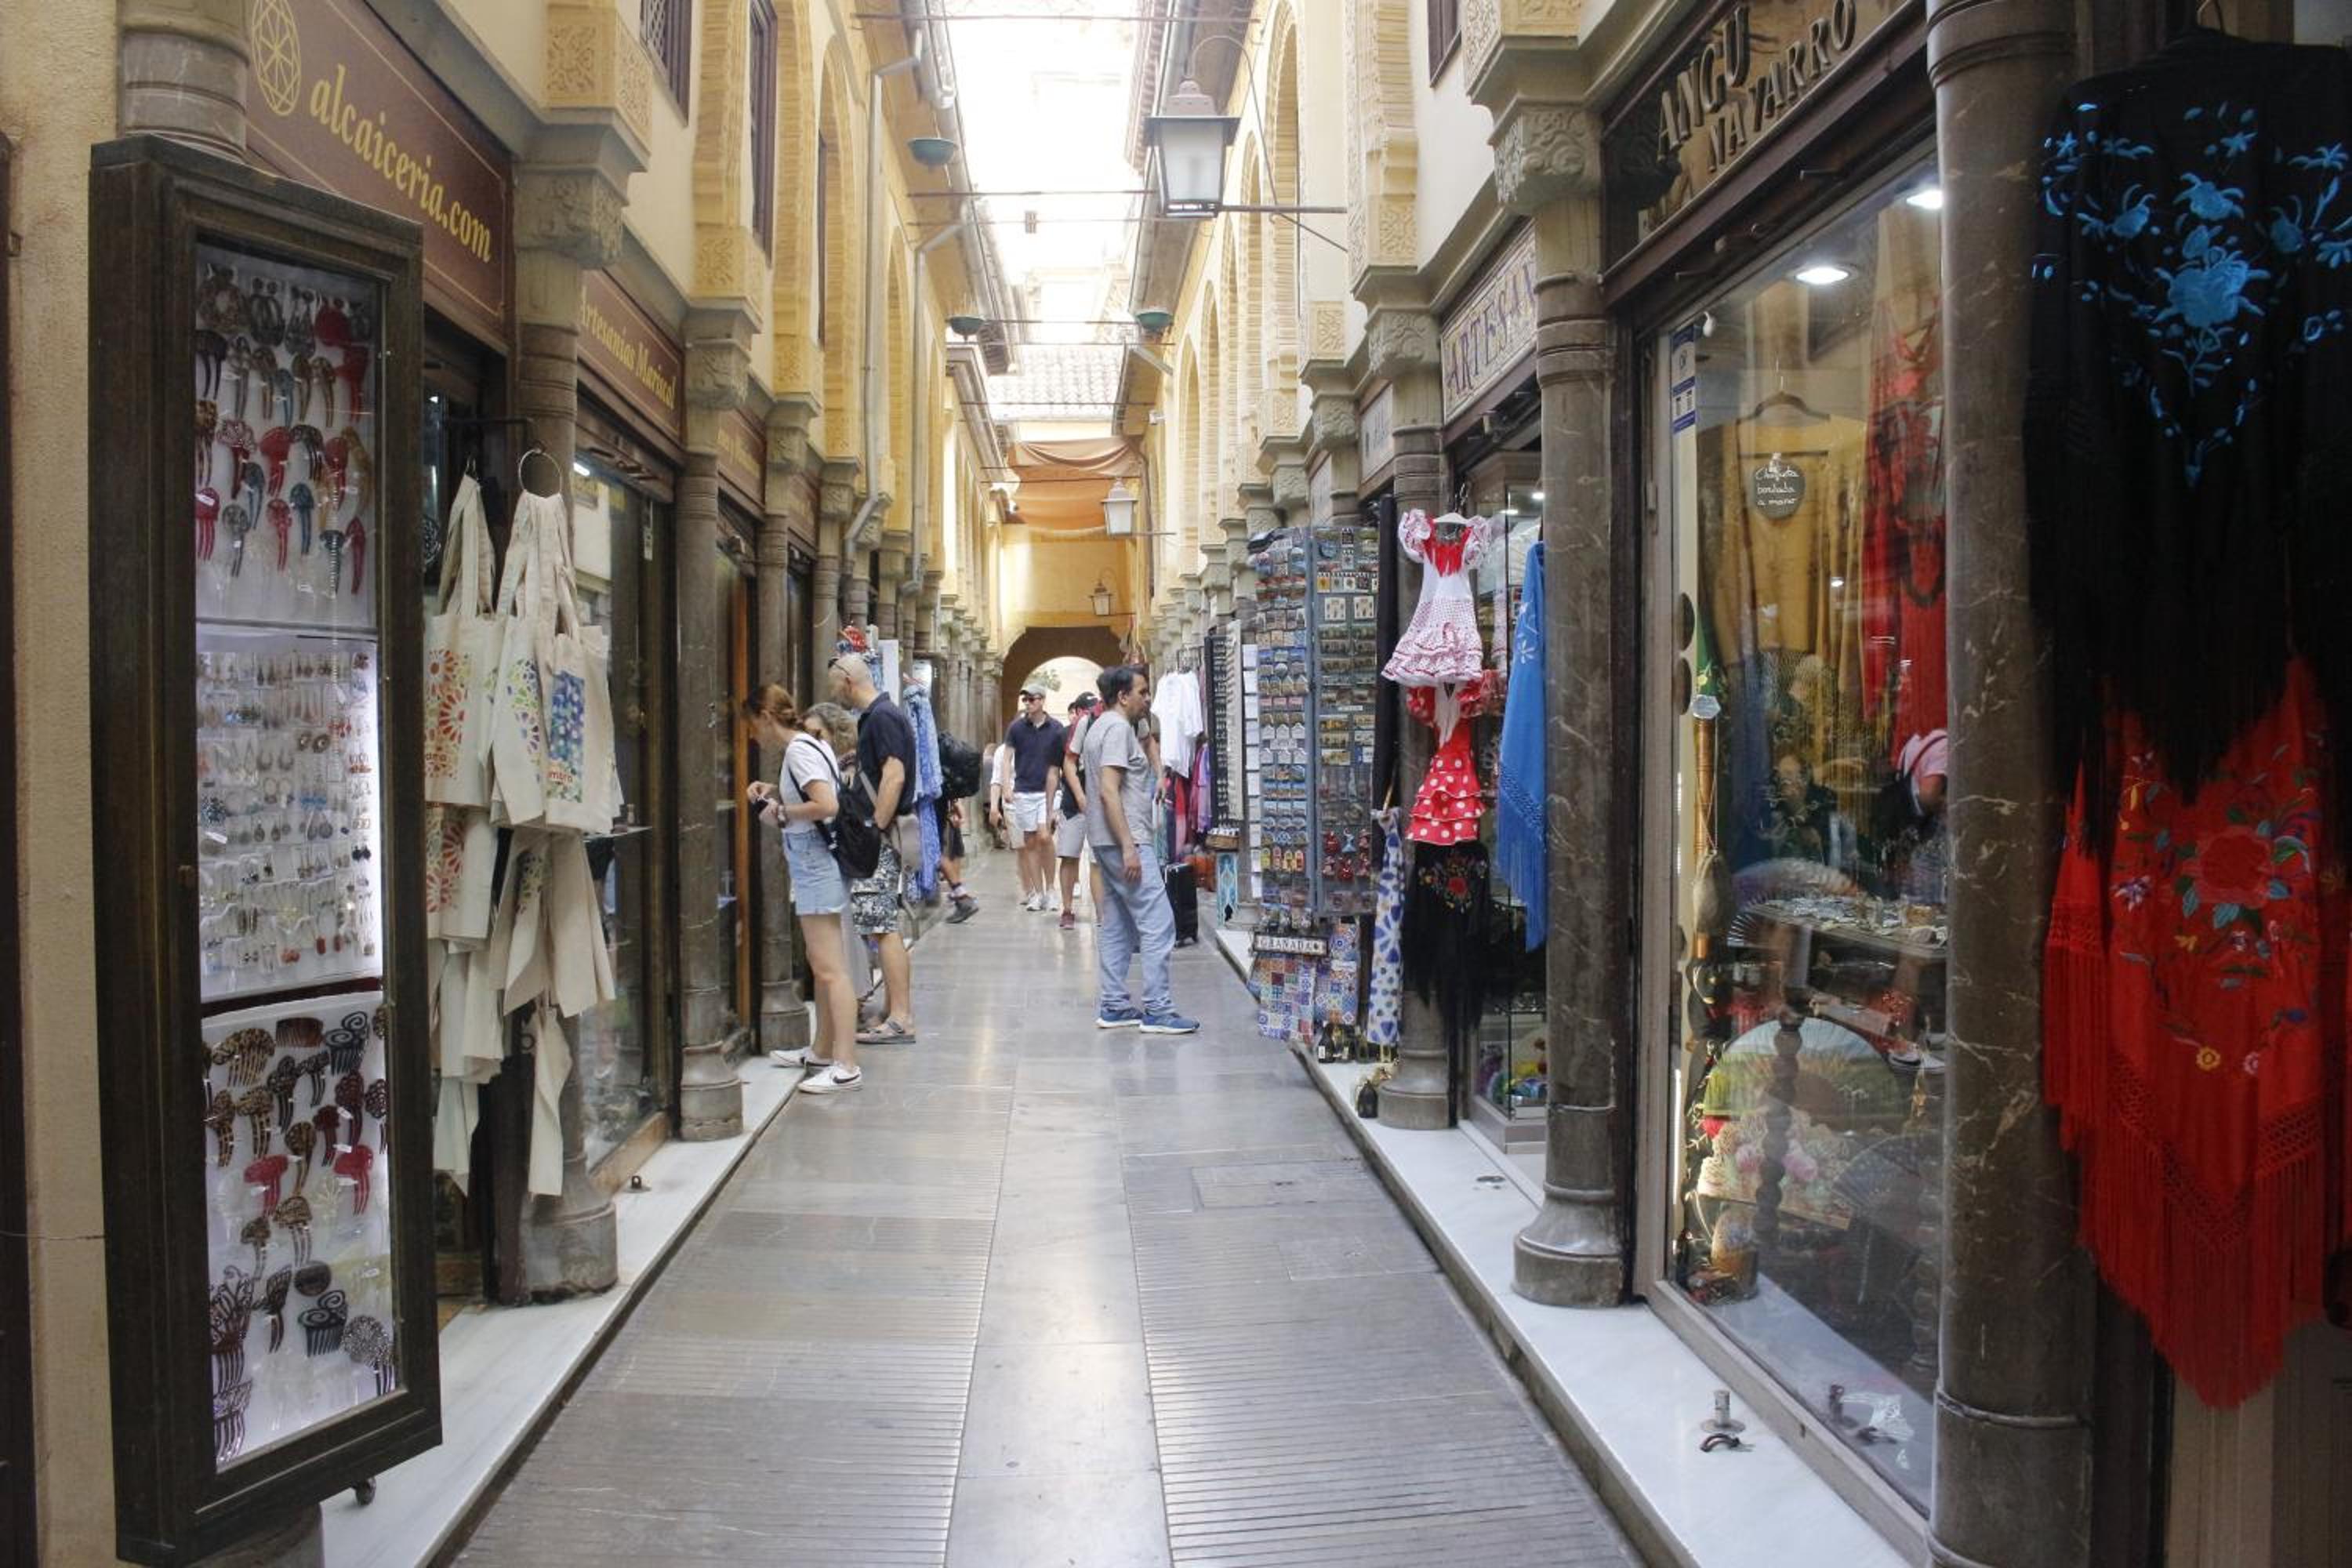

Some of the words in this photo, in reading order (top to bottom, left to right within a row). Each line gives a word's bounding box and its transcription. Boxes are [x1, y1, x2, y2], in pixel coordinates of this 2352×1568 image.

[310, 63, 492, 263] alcaiceria.com
[1656, 6, 1750, 162] ANGU
[1708, 0, 1857, 173] NAVARRO
